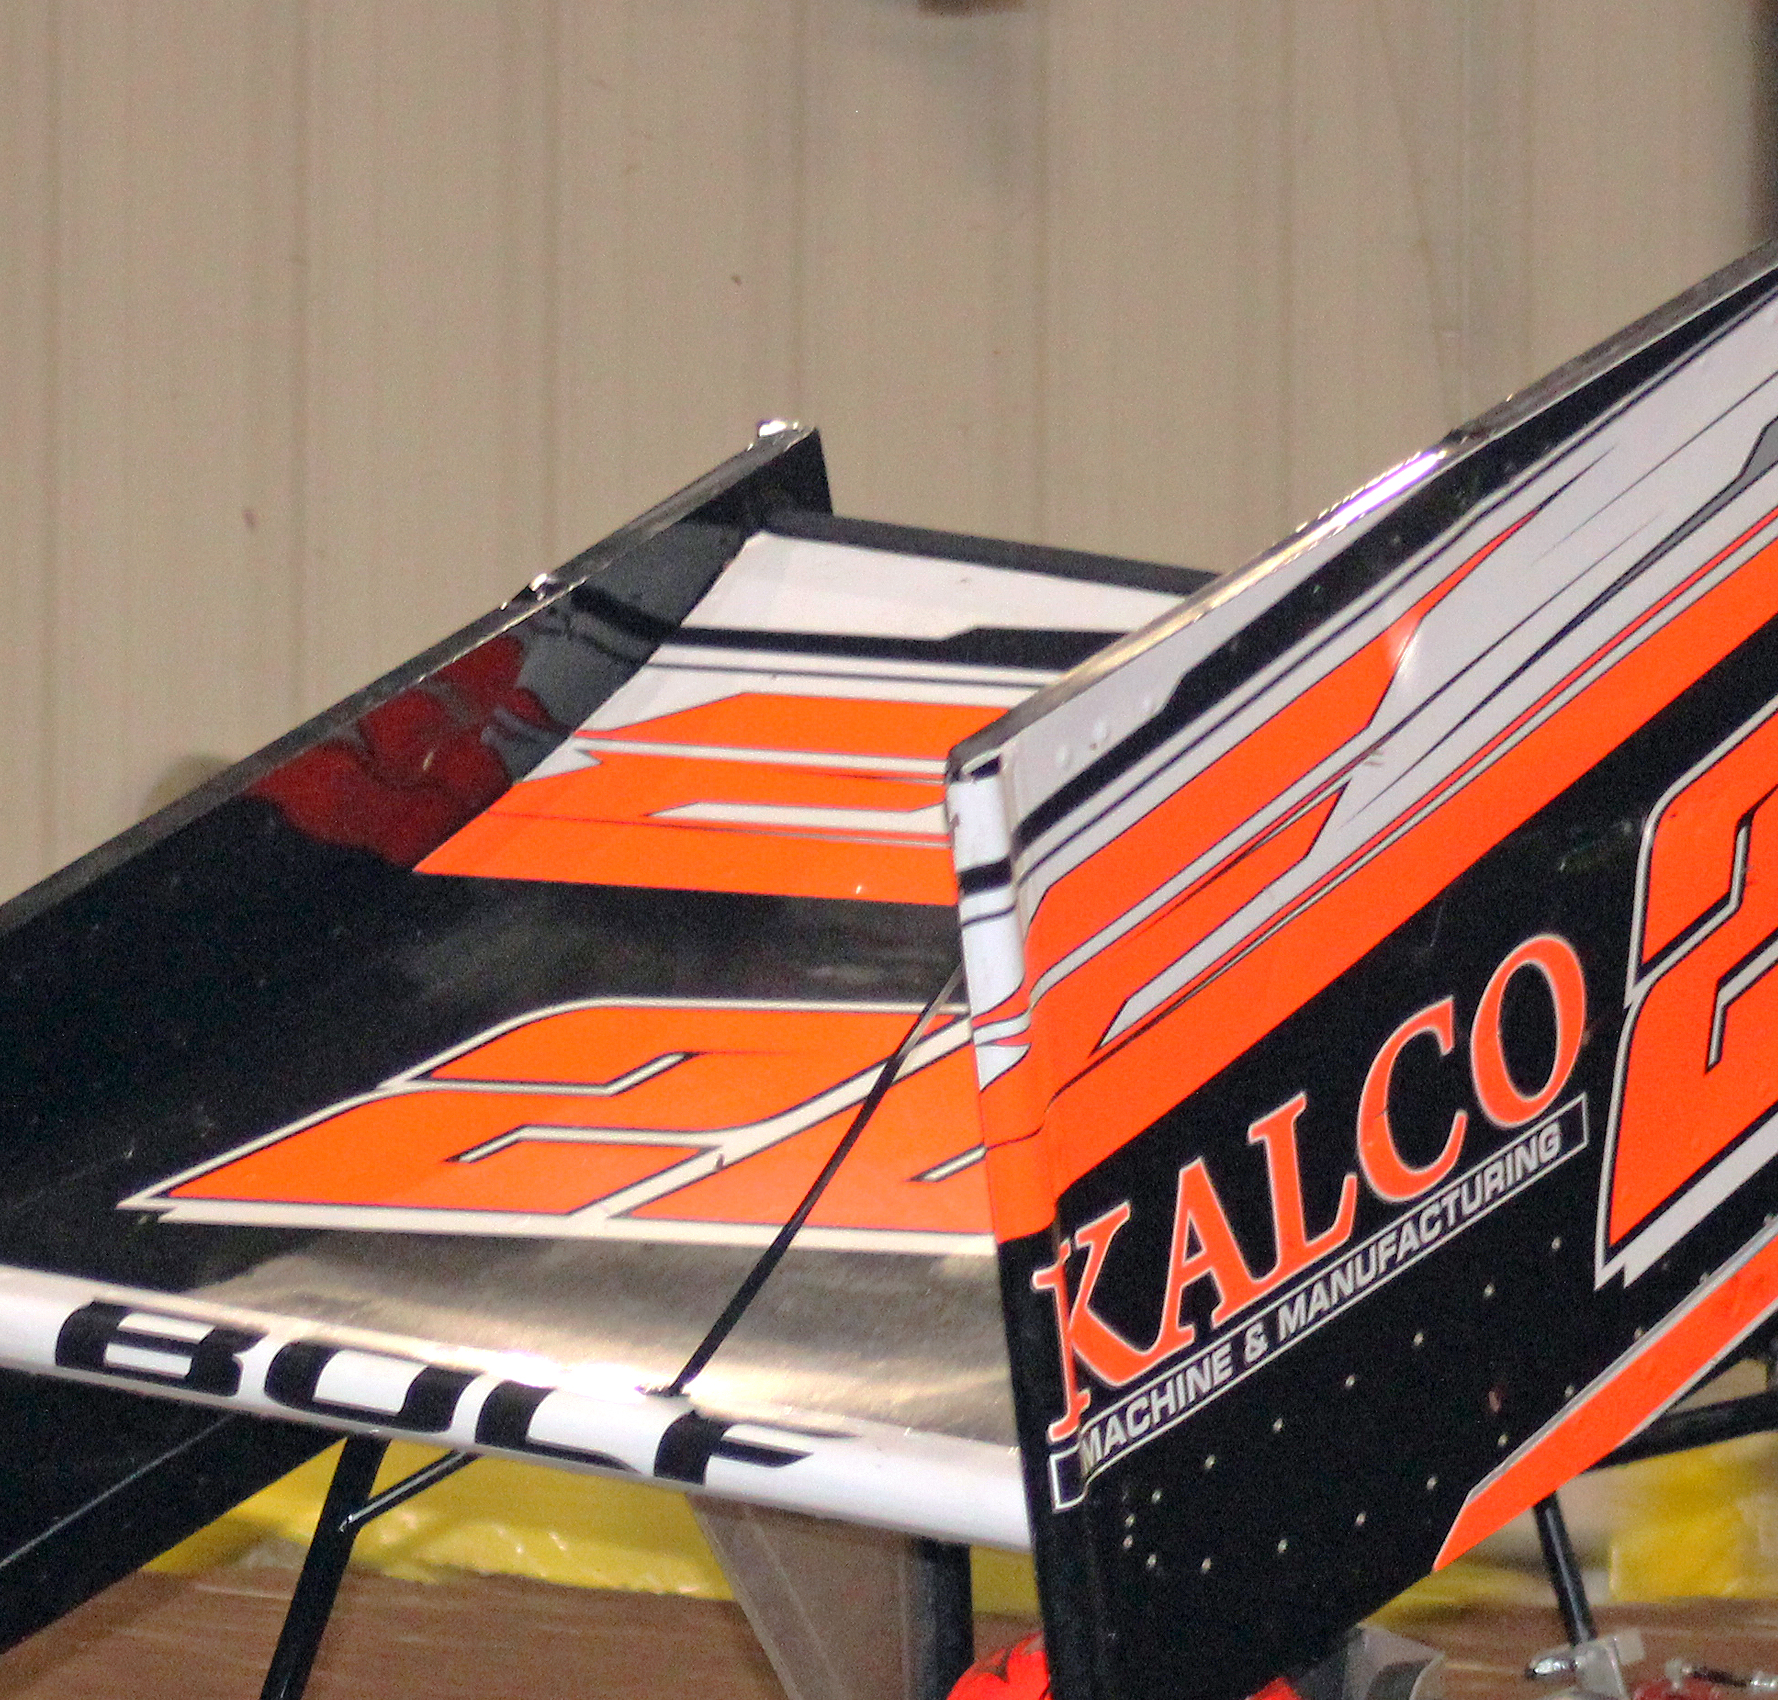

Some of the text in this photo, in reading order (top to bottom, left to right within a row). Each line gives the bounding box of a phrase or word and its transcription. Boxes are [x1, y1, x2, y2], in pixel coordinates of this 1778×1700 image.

[1032, 932, 1586, 1441] KALCO
[1078, 1121, 1561, 1476] MACHINE & MANUFACTURING
